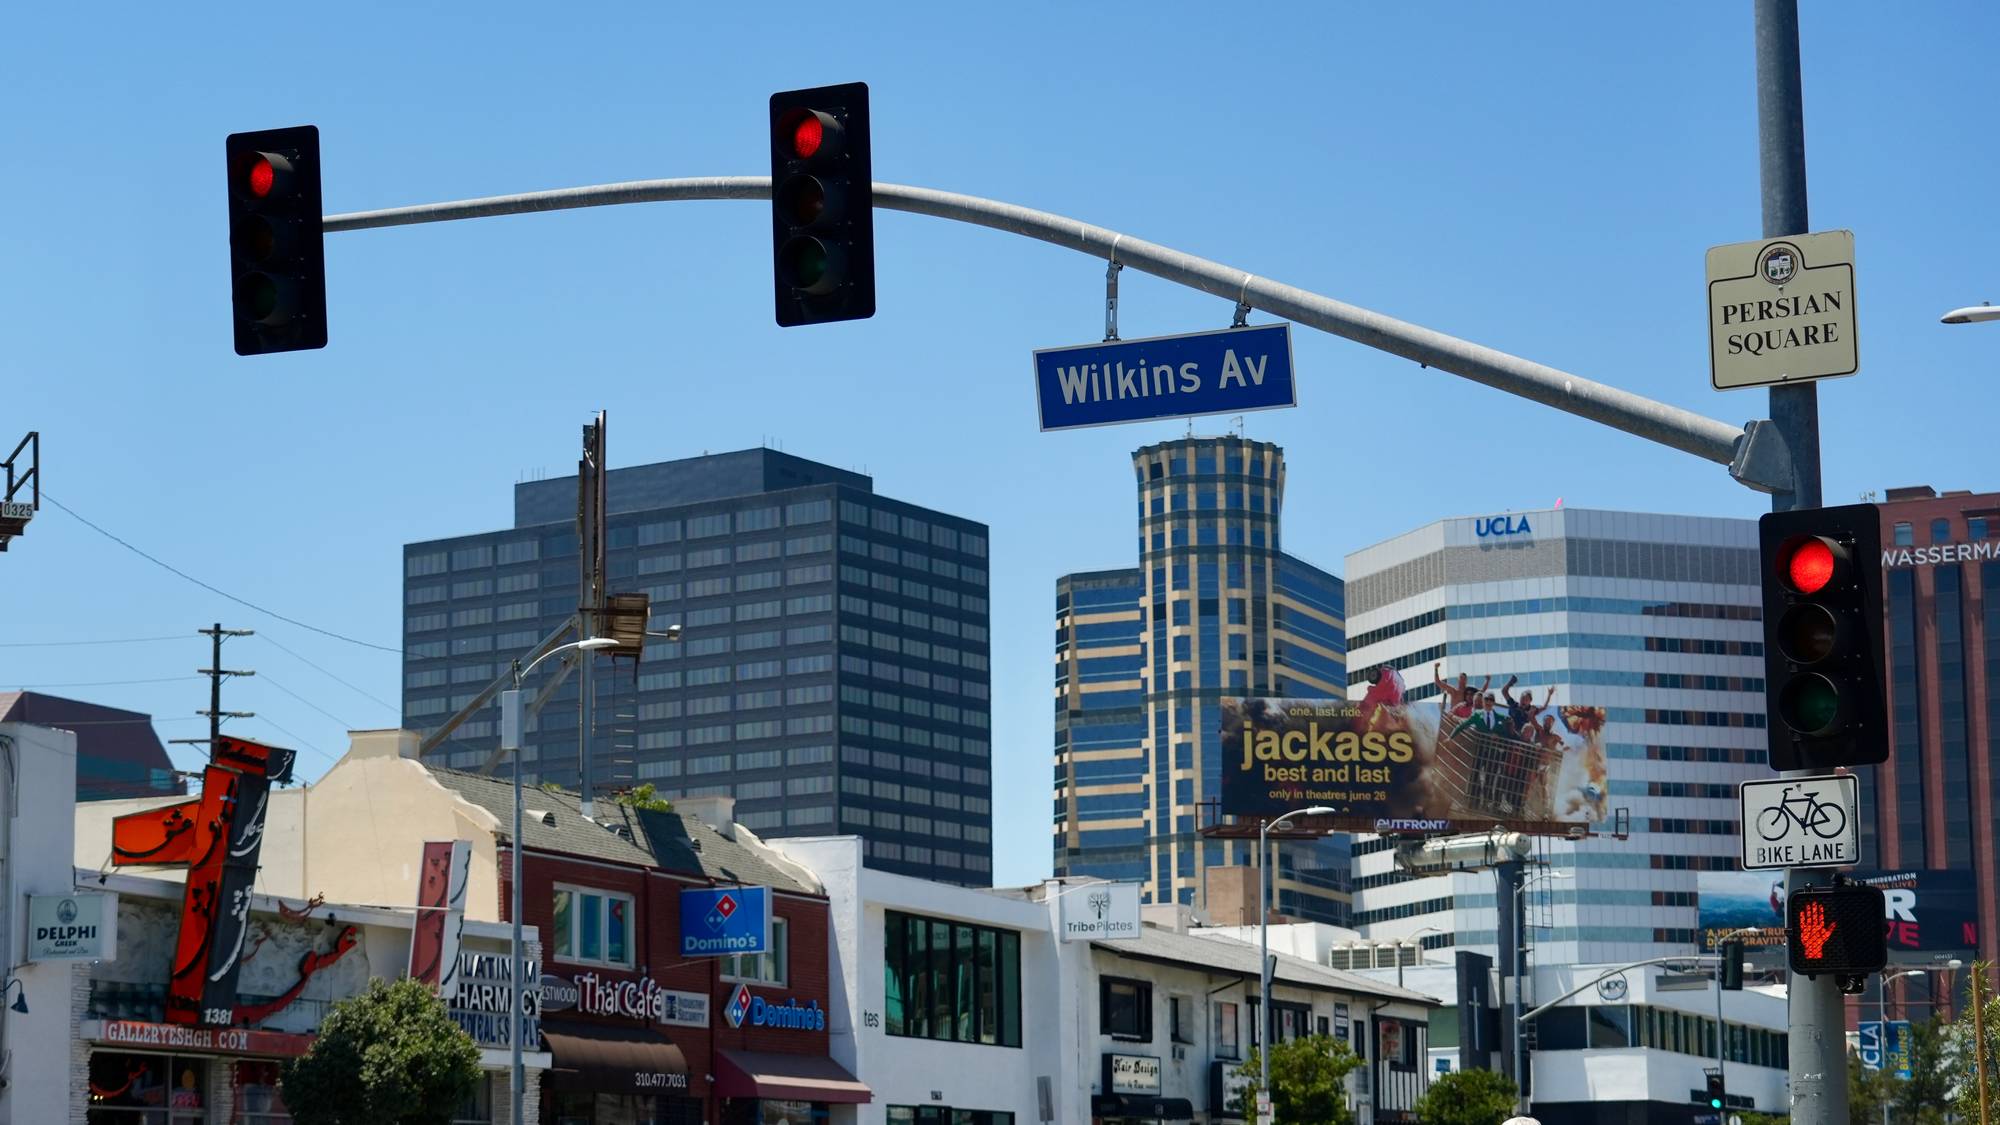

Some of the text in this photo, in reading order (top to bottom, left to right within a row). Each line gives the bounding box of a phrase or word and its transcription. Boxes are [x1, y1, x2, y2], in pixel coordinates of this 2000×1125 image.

[1721, 290, 1842, 326] PERSIAN
[1727, 322, 1840, 356] SQUARE
[1056, 348, 1268, 405] Wilkins Av
[3, 503, 33, 516] 0325
[1475, 515, 1532, 537] UCLA
[1289, 706, 1364, 718] one. last. ride.
[1241, 720, 1414, 771] jackass
[1264, 764, 1391, 783] best and last
[1268, 788, 1386, 803] only in theatres june 26
[1757, 842, 1845, 864] BIKE LANE
[37, 926, 97, 941] DELPHI
[684, 932, 758, 951] Domino's
[1962, 922, 1977, 945] N
[455, 982, 541, 1016] HARMCY
[577, 972, 662, 1018] Thai Café
[204, 1008, 233, 1025] 1381
[752, 996, 825, 1031] Domino's
[1133, 1059, 1159, 1077] Design
[634, 1071, 688, 1089] 310.477.7031
